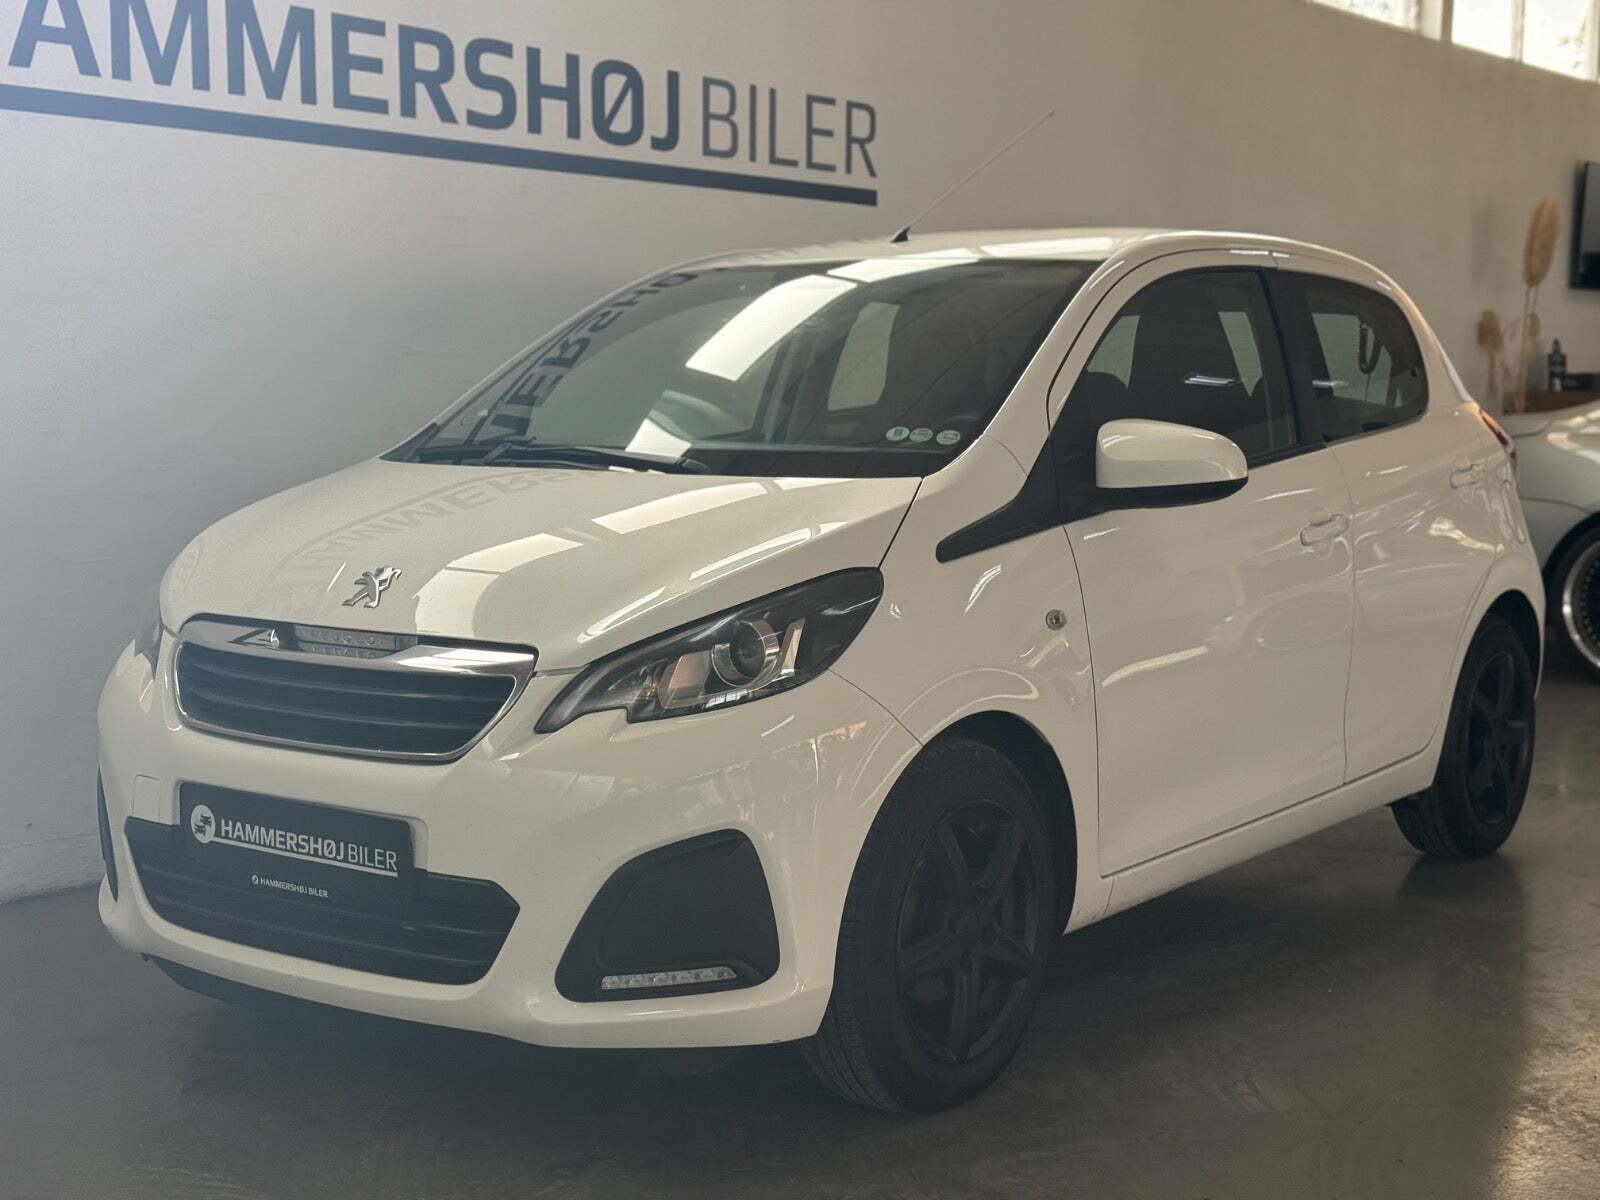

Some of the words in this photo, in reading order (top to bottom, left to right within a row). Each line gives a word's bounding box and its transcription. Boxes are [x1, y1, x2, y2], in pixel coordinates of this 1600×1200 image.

[702, 76, 877, 178] BILER
[221, 819, 345, 861] HAMMERSHØJ
[347, 843, 398, 871] BILER
[308, 887, 329, 898] BILER
